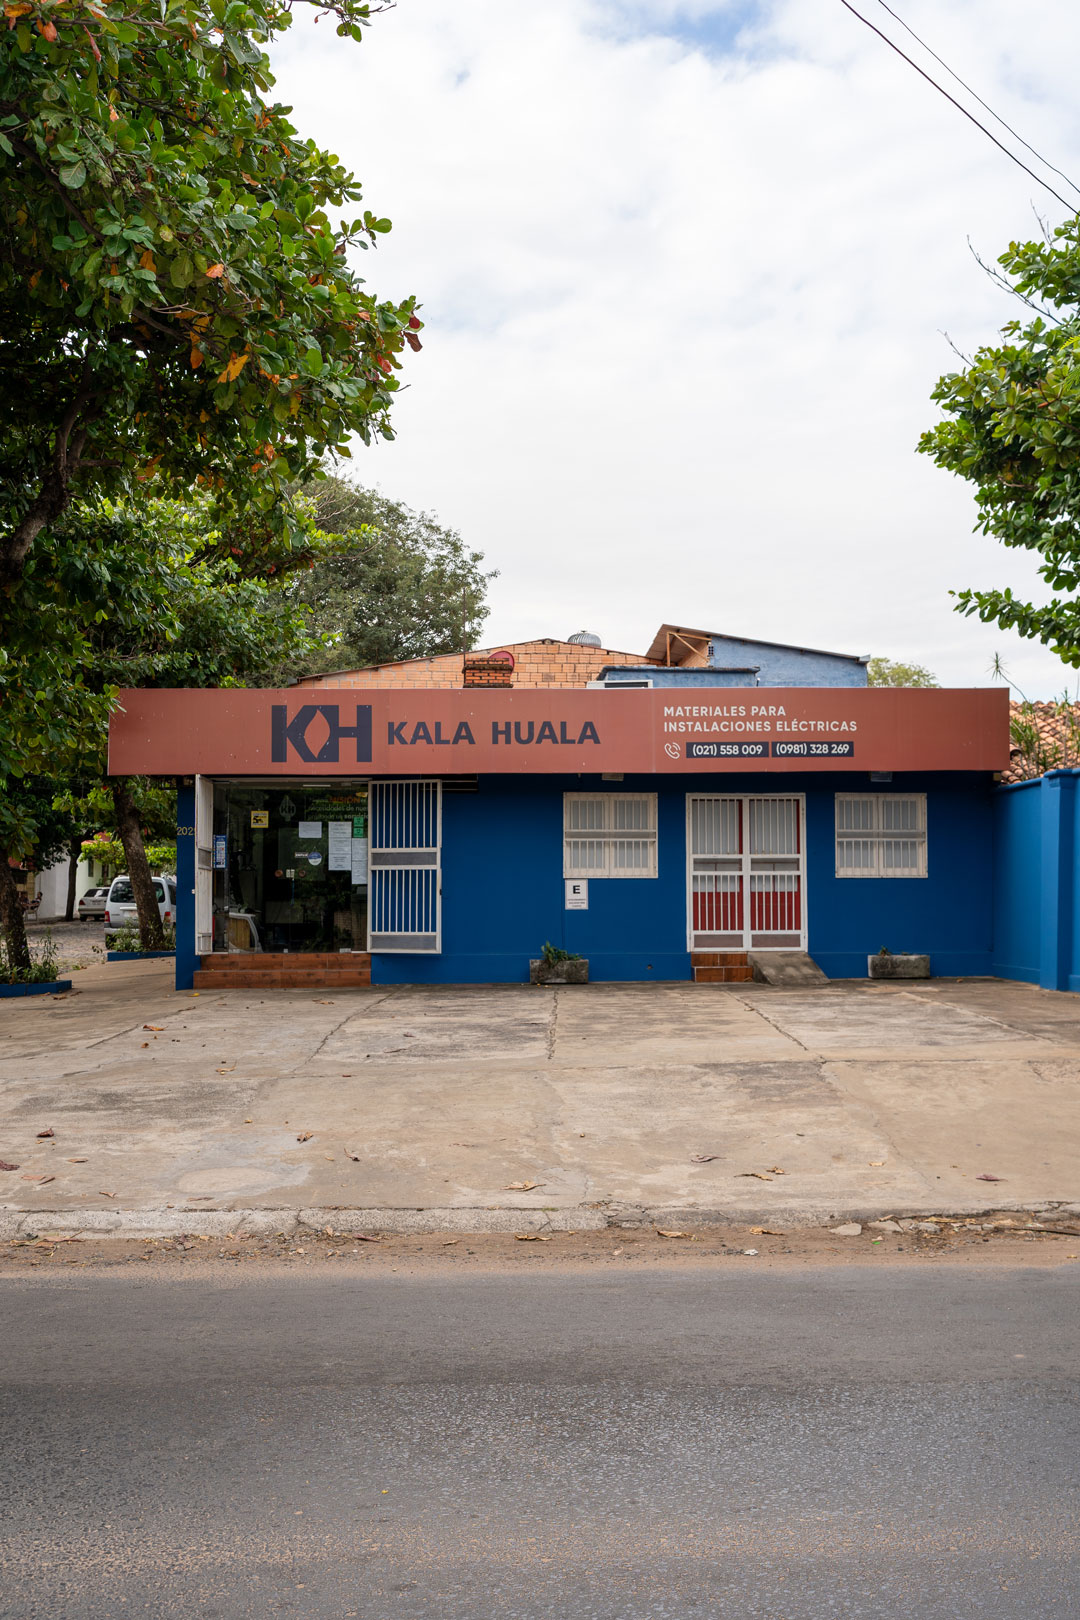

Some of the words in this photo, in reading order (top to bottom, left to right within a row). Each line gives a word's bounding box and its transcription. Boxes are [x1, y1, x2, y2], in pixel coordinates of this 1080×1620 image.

[663, 705, 746, 717] MATERIALES
[751, 705, 786, 716] PARA
[663, 721, 771, 733] INSTALACIONES
[776, 718, 857, 732] ELÉCTRICAS
[271, 705, 372, 763] KH
[388, 721, 476, 745] KALA
[492, 721, 600, 745] HUALA
[692, 744, 717, 756] (021)
[720, 744, 739, 755] 558
[741, 744, 763, 755] 009
[776, 743, 807, 755] (0981)
[810, 744, 828, 754] 328
[831, 743, 850, 754] 269
[176, 826, 195, 836] 202
[573, 885, 581, 894] E
